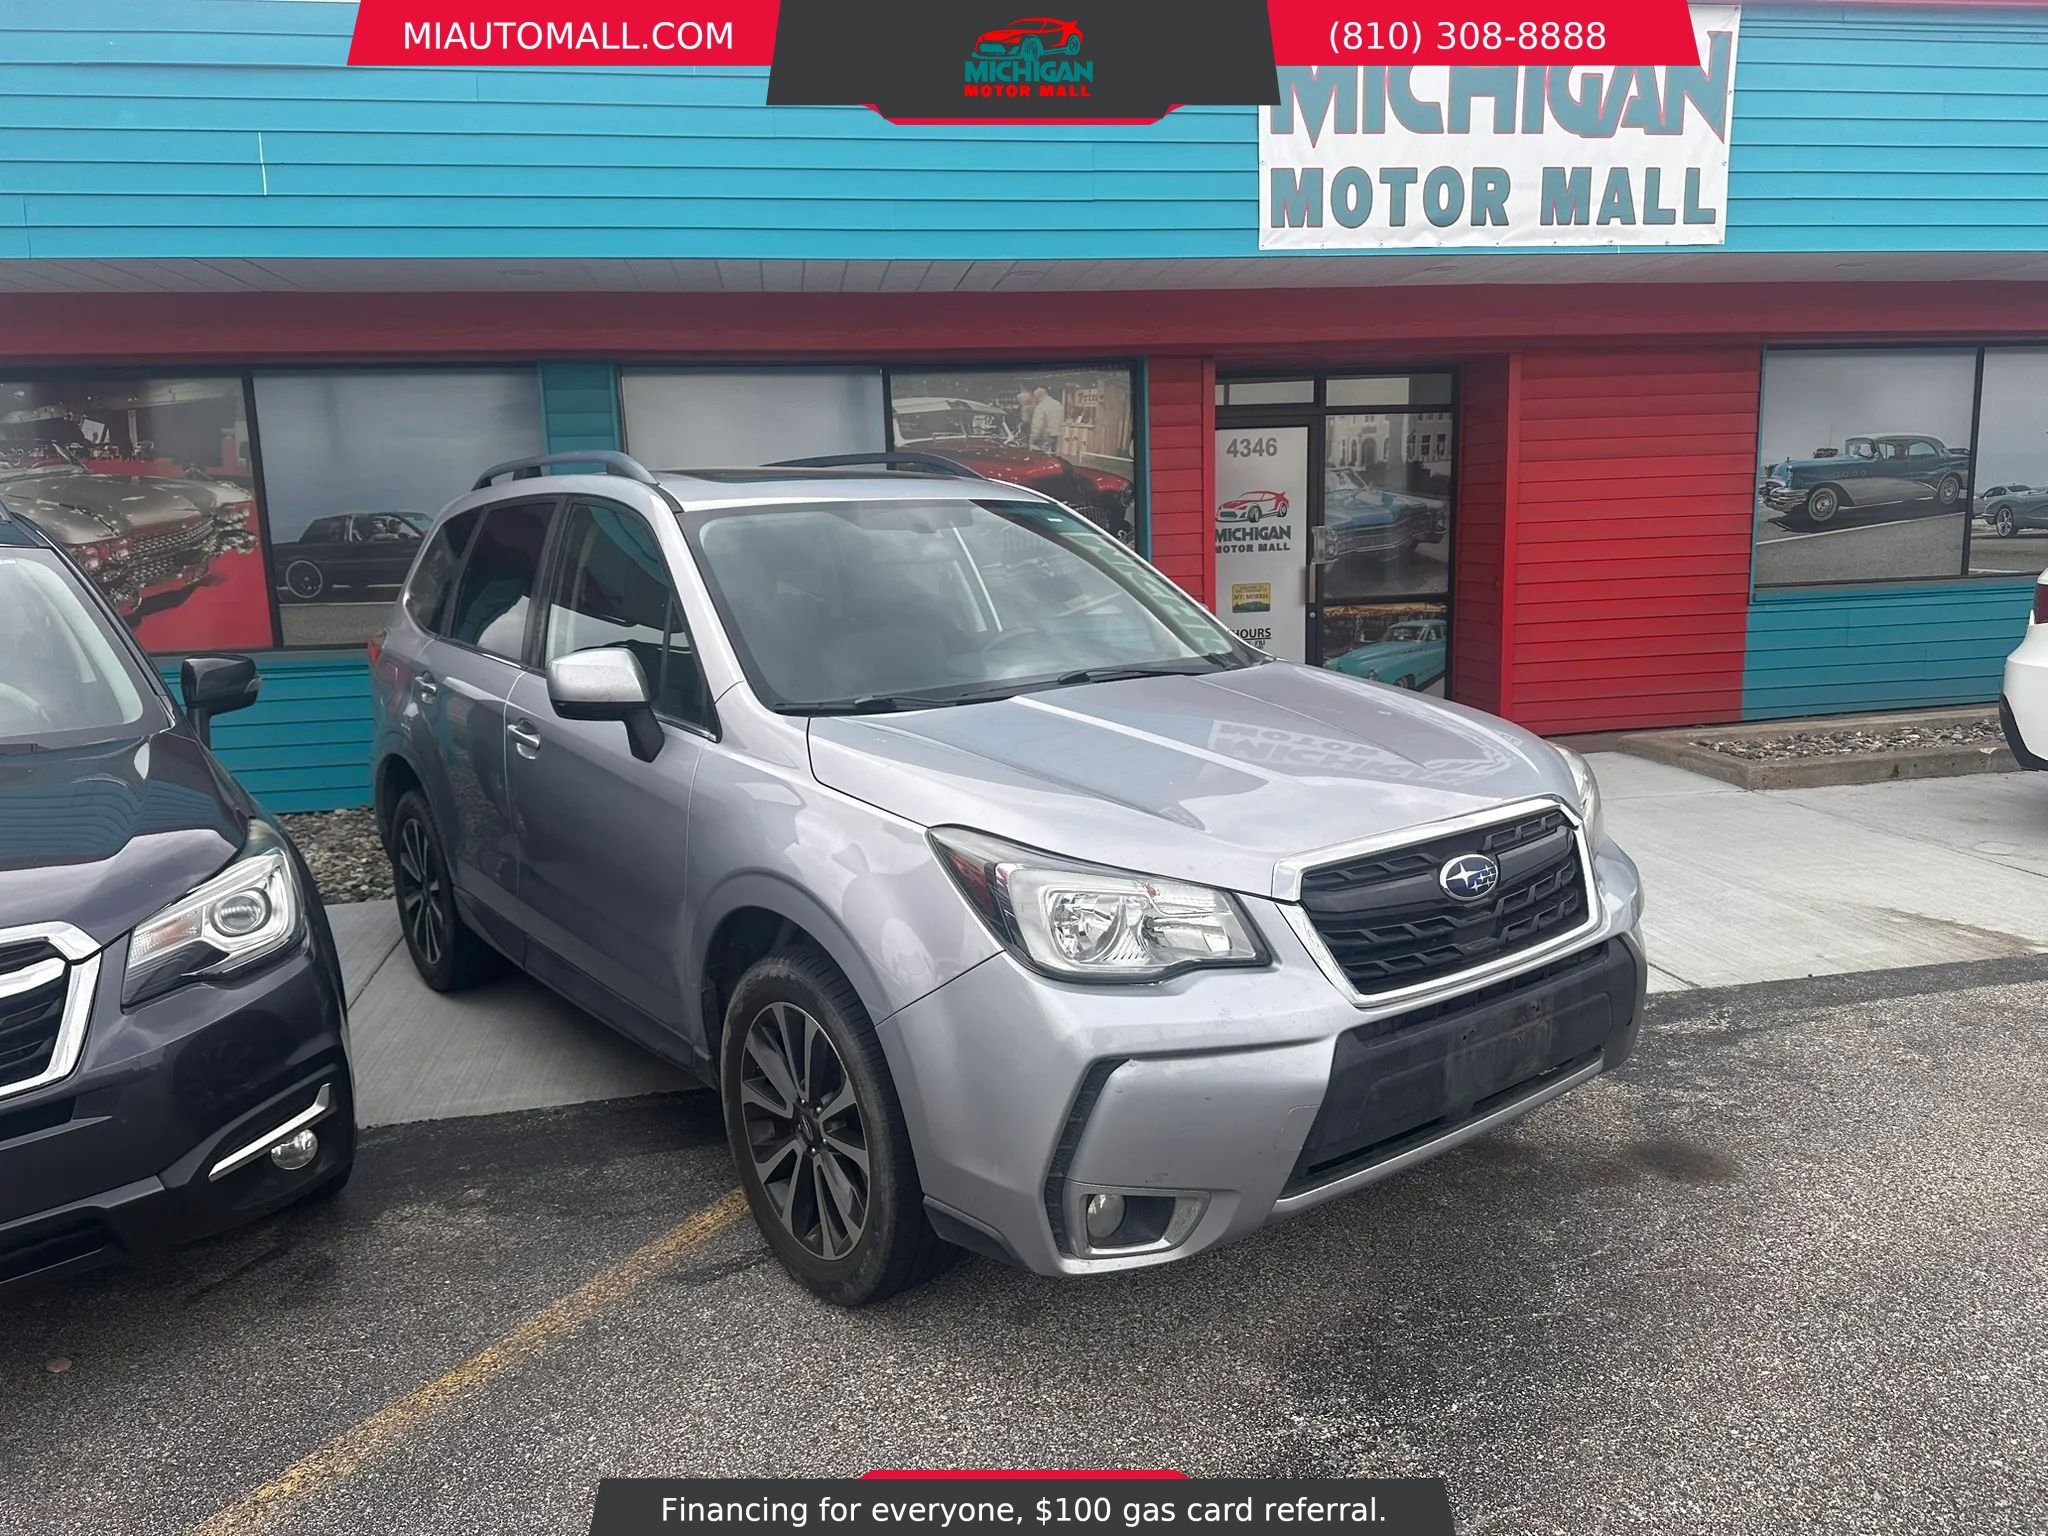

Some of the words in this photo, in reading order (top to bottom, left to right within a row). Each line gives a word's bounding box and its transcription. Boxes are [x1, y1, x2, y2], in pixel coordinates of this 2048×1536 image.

[1270, 166, 1510, 229] MOTOR
[1540, 167, 1716, 226] MALL
[1226, 437, 1278, 458] 4346
[1258, 542, 1291, 552] MALL
